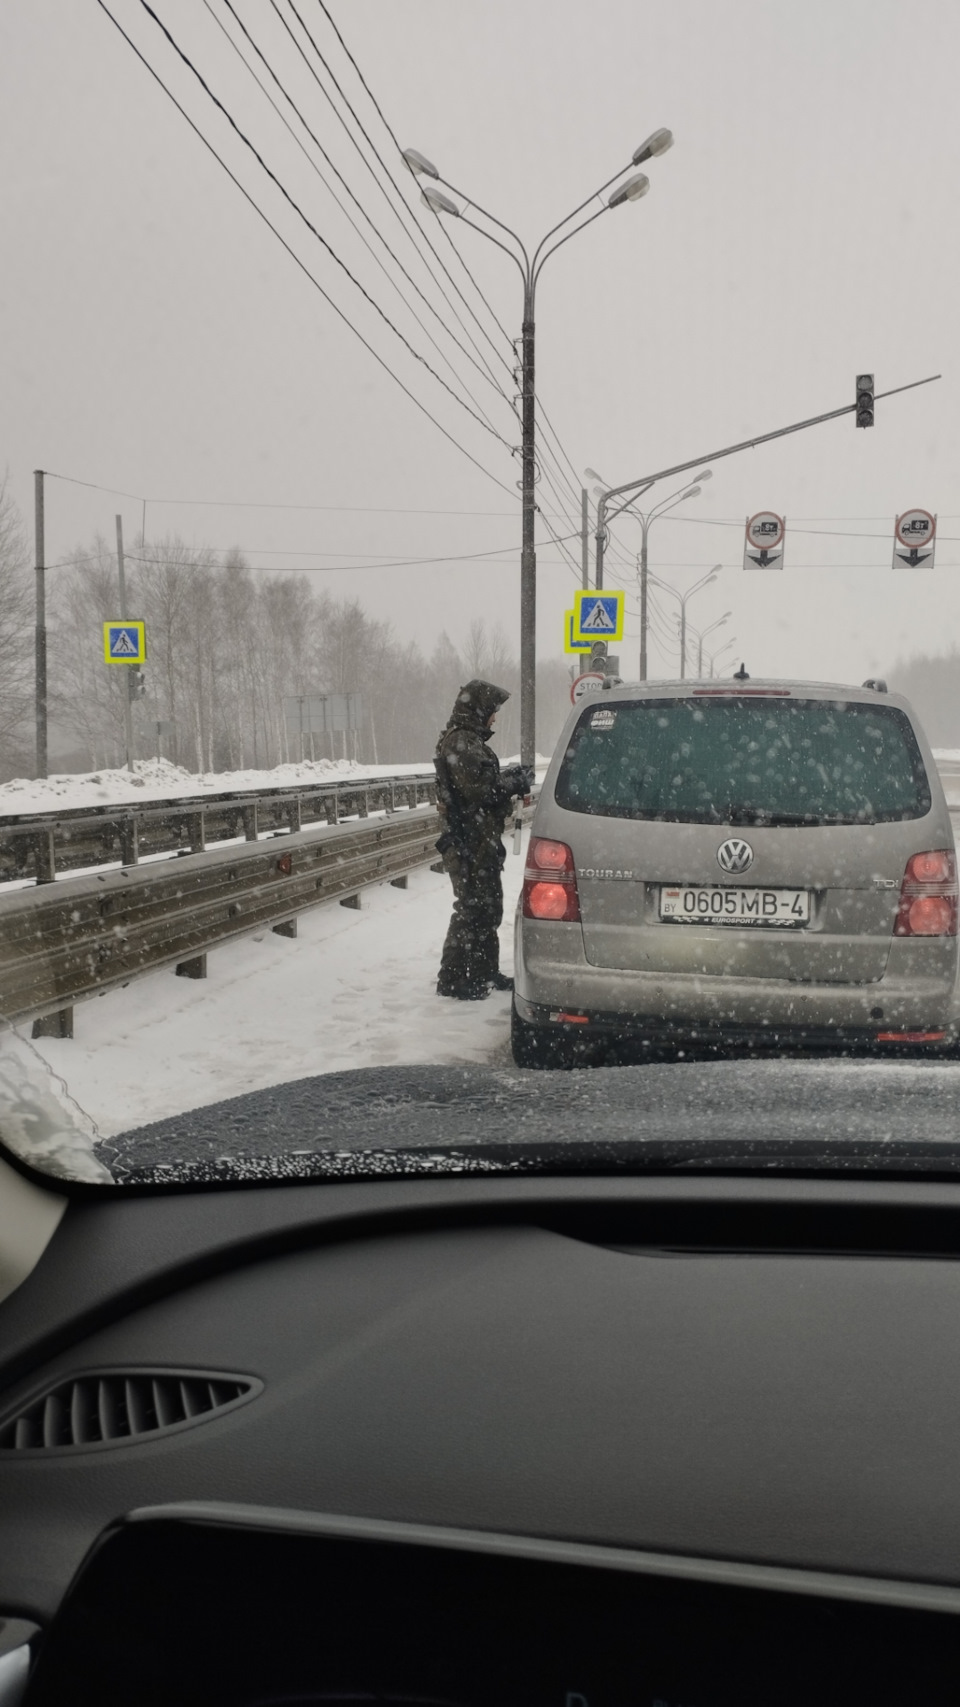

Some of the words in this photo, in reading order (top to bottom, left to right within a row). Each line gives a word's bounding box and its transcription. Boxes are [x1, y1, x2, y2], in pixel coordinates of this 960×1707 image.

[578, 868, 633, 878] TOURAN
[872, 879, 899, 888] TDI
[664, 903, 677, 913] BY
[711, 916, 756, 925] EUROSPORT
